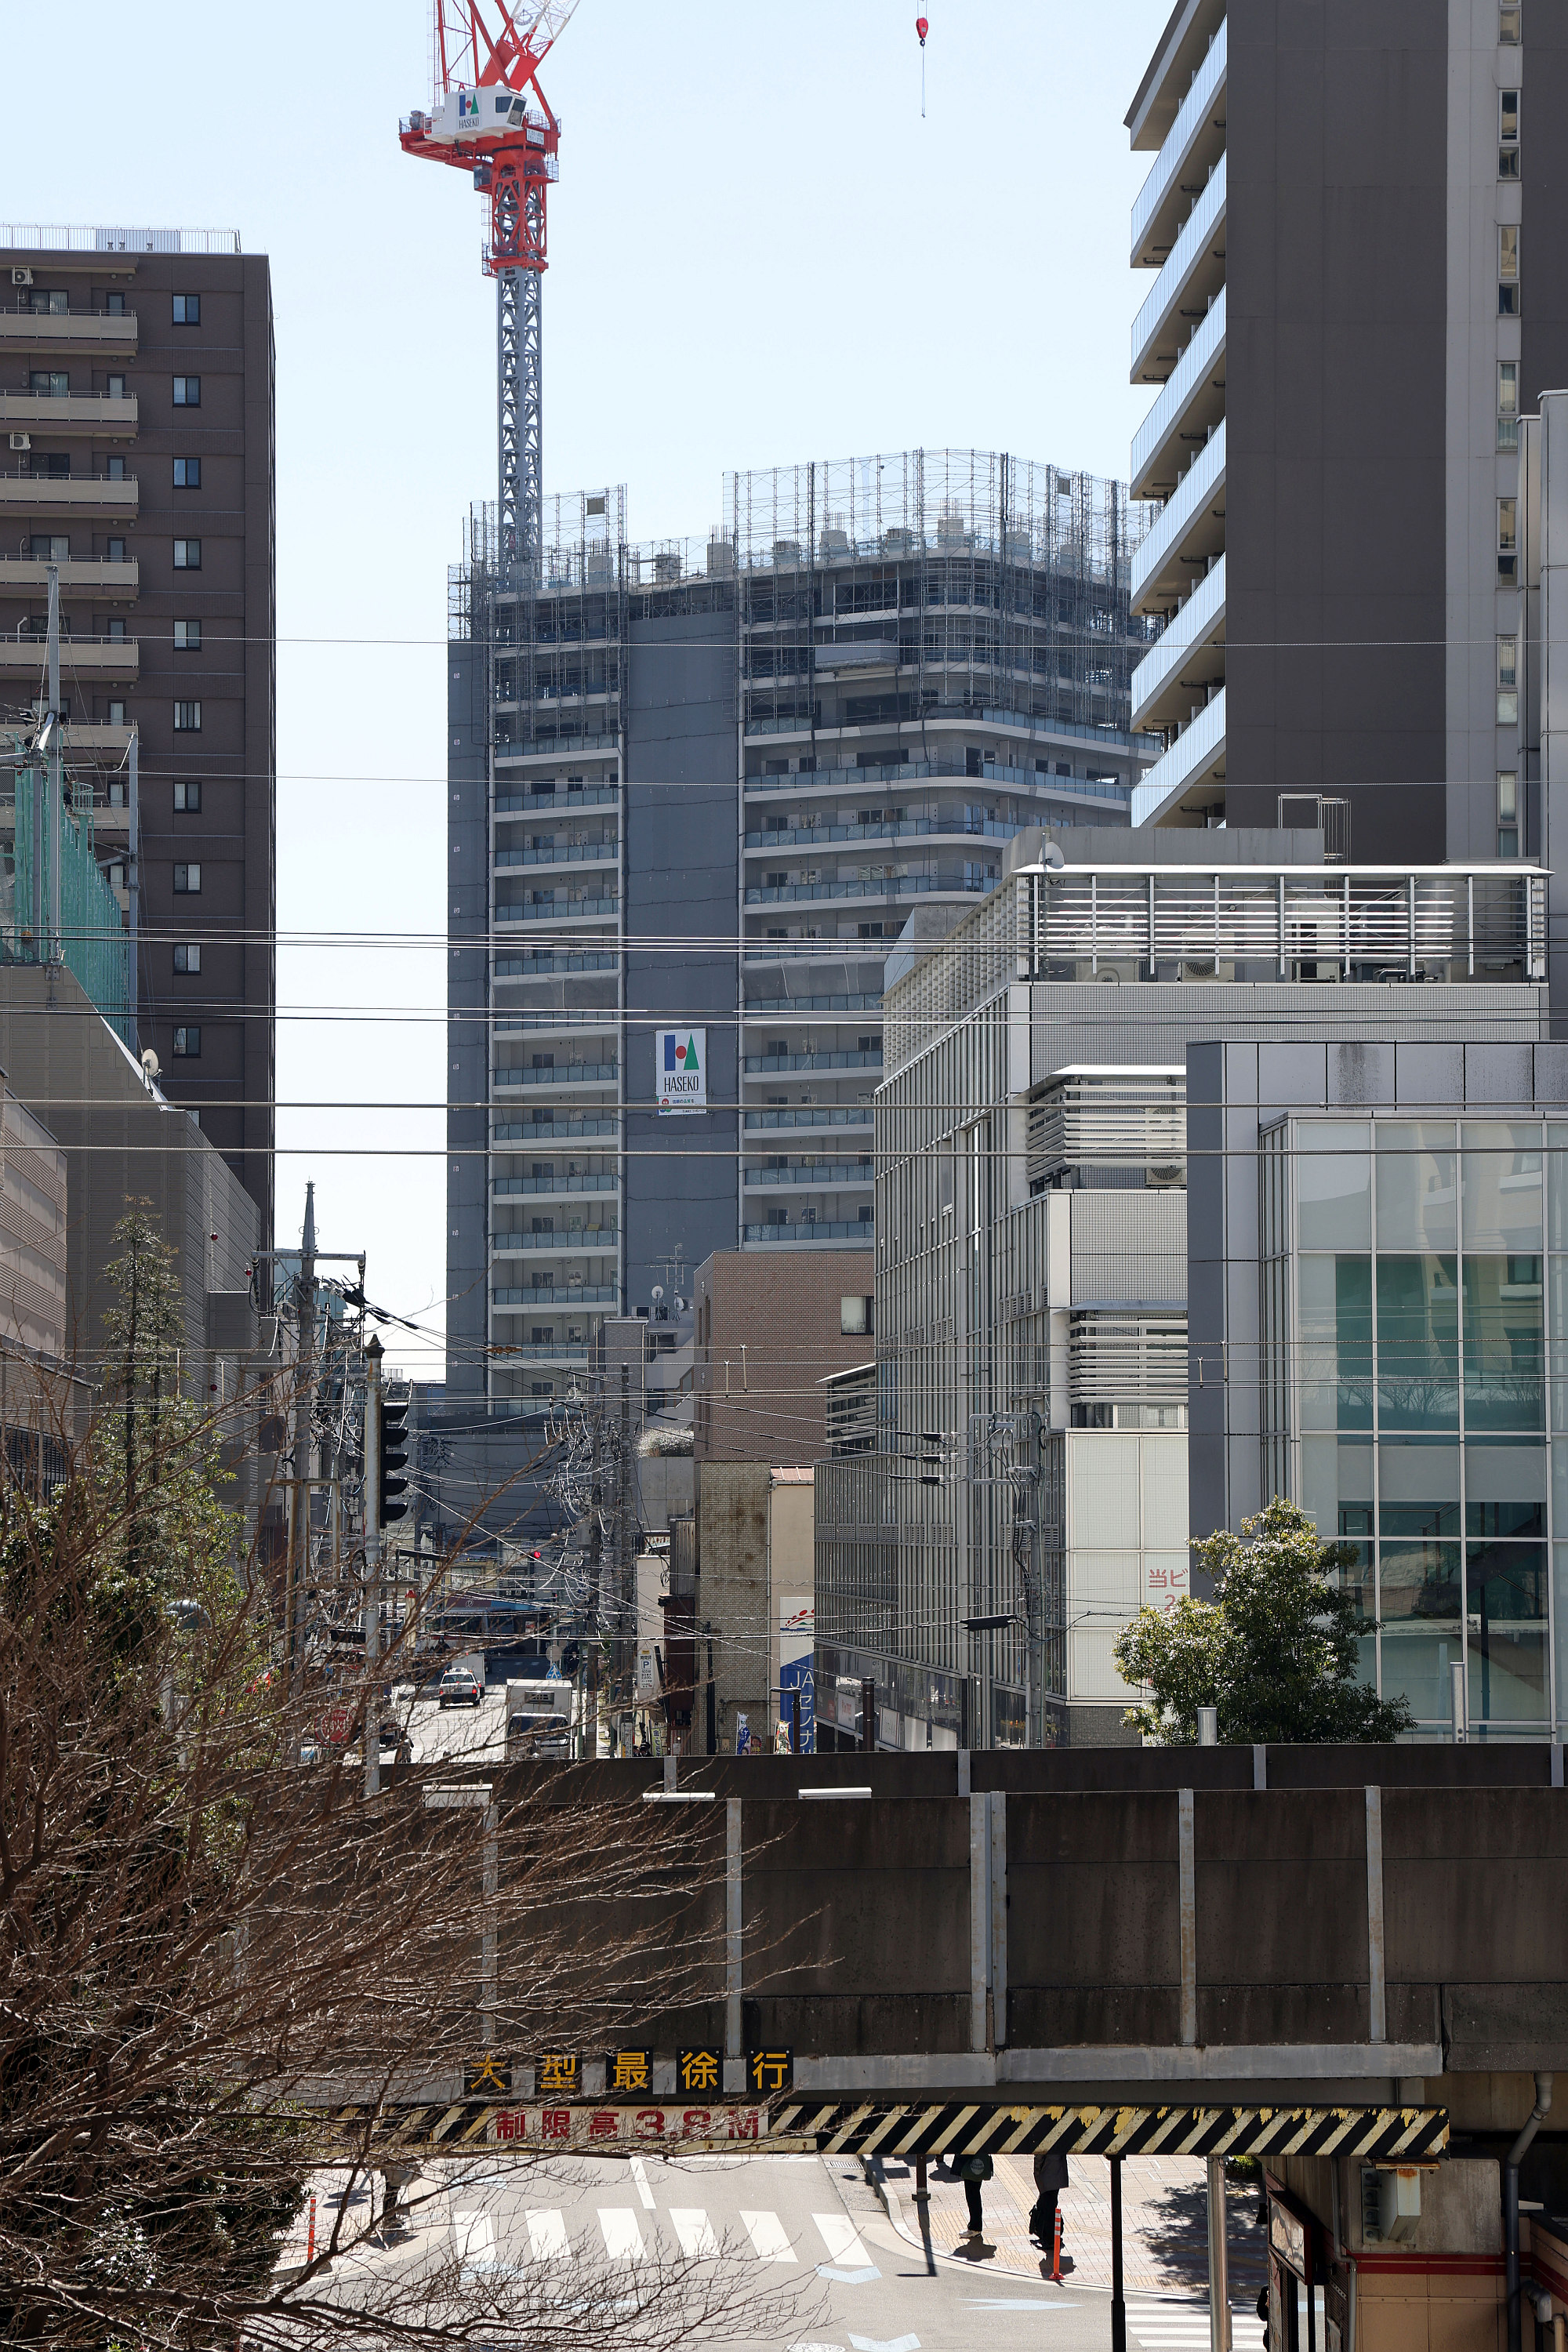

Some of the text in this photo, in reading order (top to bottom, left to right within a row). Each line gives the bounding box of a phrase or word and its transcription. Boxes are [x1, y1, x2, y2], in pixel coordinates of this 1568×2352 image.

[459, 117, 479, 129] HASEKO
[664, 1076, 699, 1092] HASEKO
[470, 2051, 788, 2089] 大型最徐行
